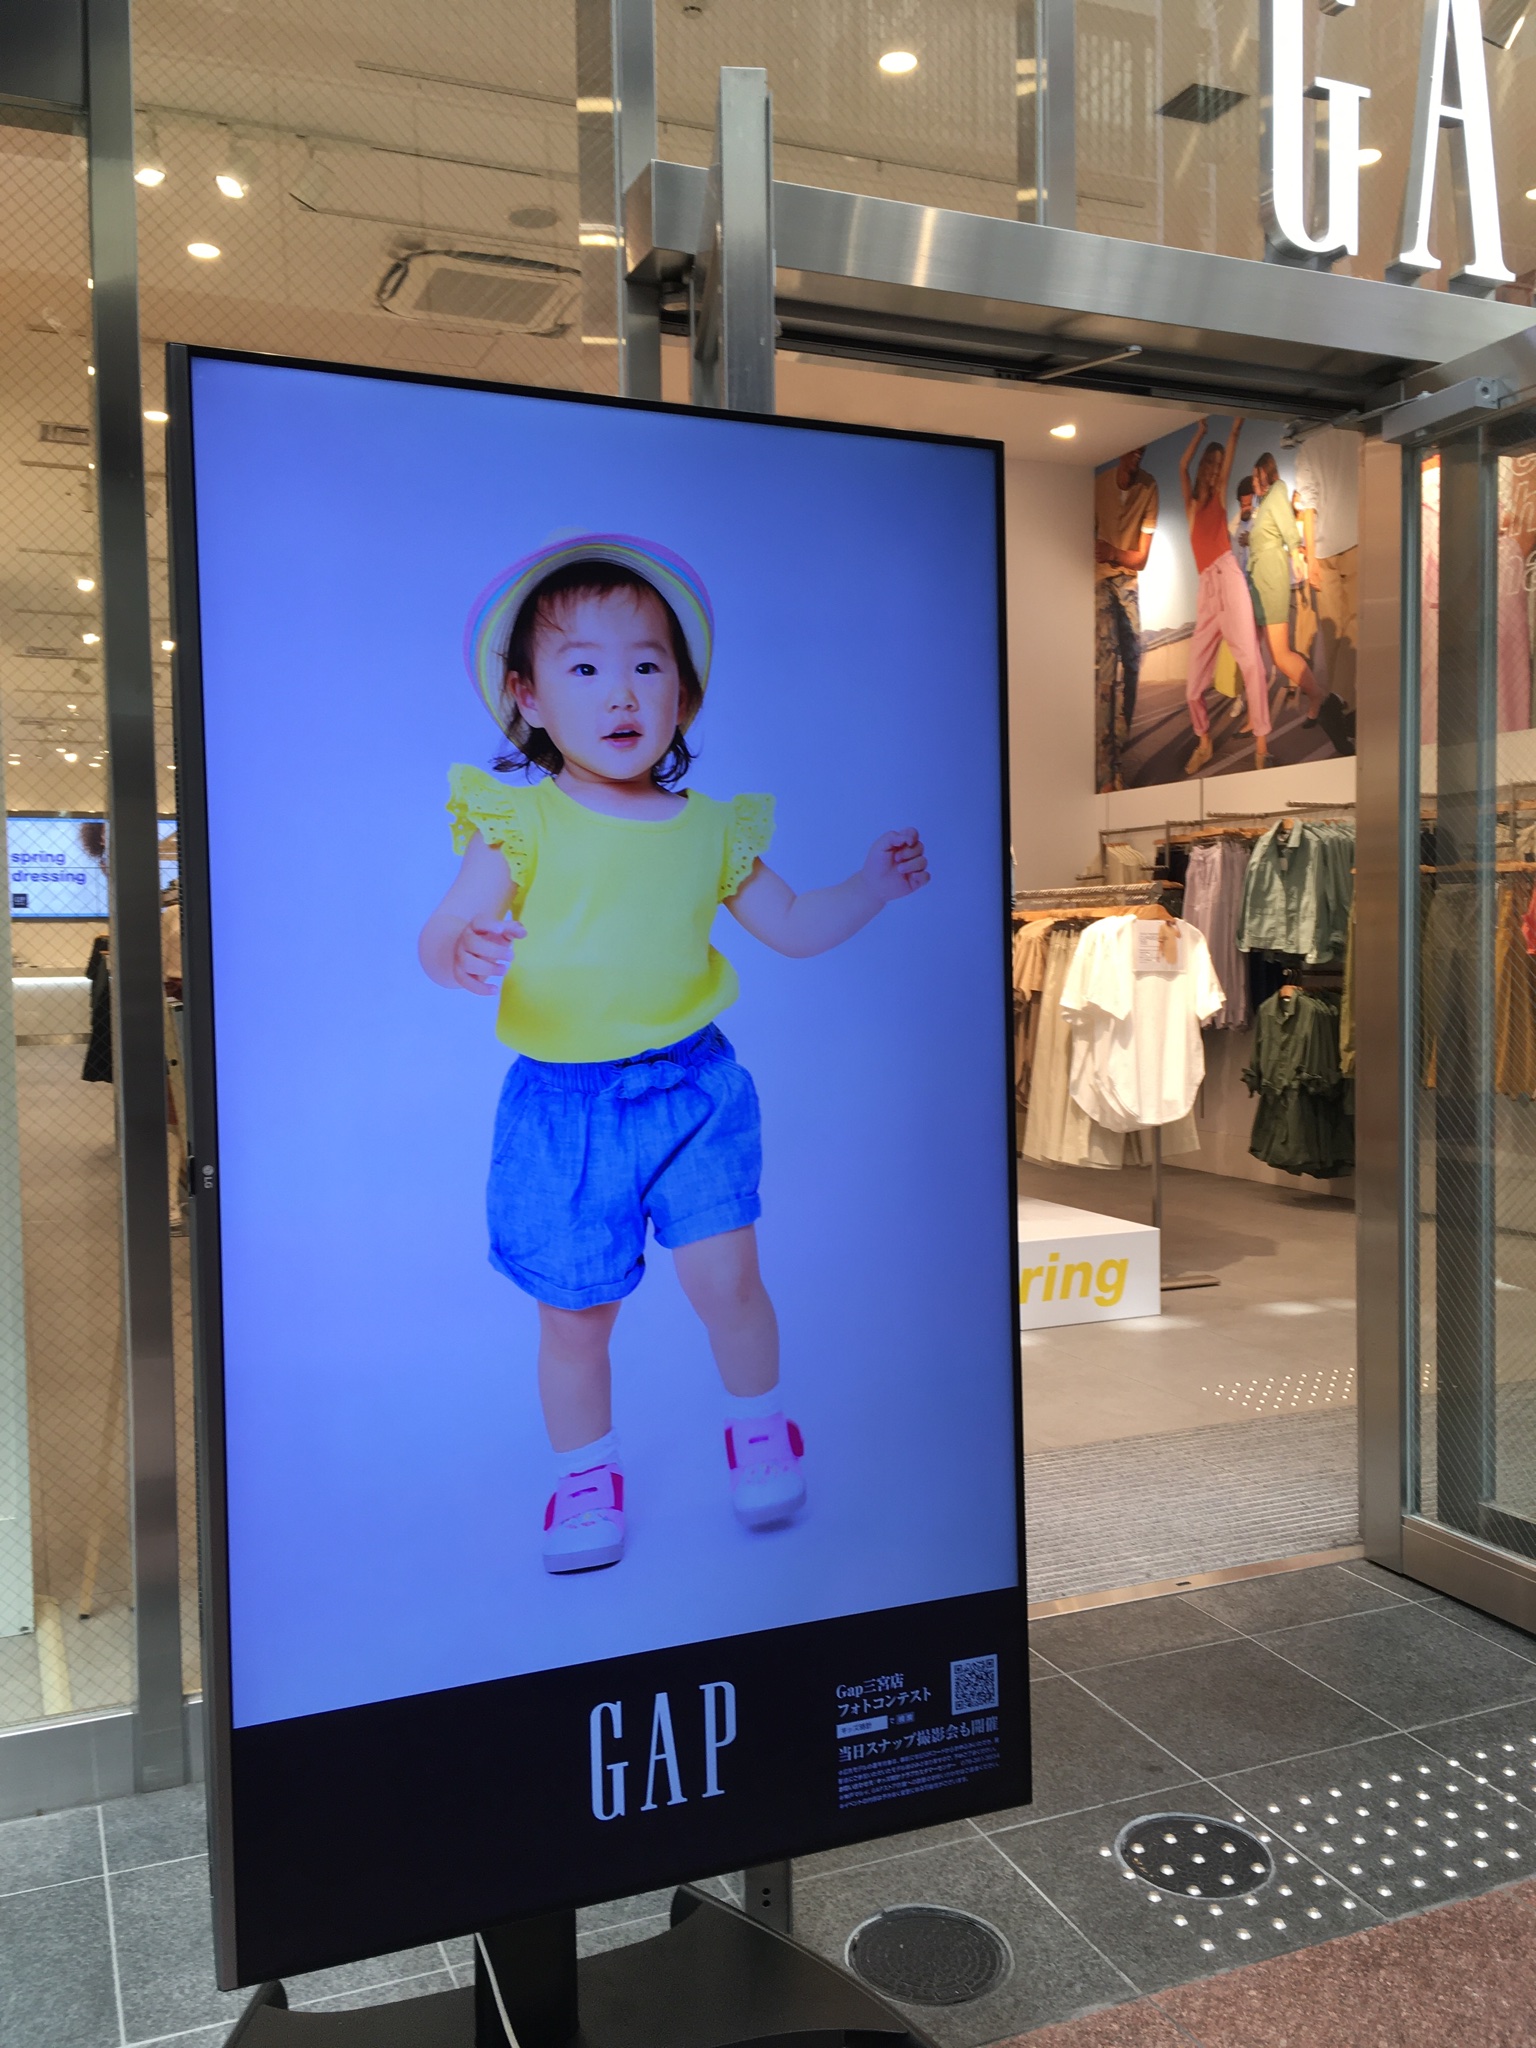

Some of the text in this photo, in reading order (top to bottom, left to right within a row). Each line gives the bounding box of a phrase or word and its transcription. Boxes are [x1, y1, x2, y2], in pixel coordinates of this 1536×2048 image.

[11, 852, 66, 864] spring
[11, 870, 87, 885] dressing
[1019, 1252, 1129, 1307] ring
[836, 1673, 904, 1699] Gap三宮店
[838, 1687, 931, 1718] フォトコンテスト
[590, 1681, 736, 1820] GAP
[838, 1716, 999, 1763] 当日スナップ撮影会も開催
